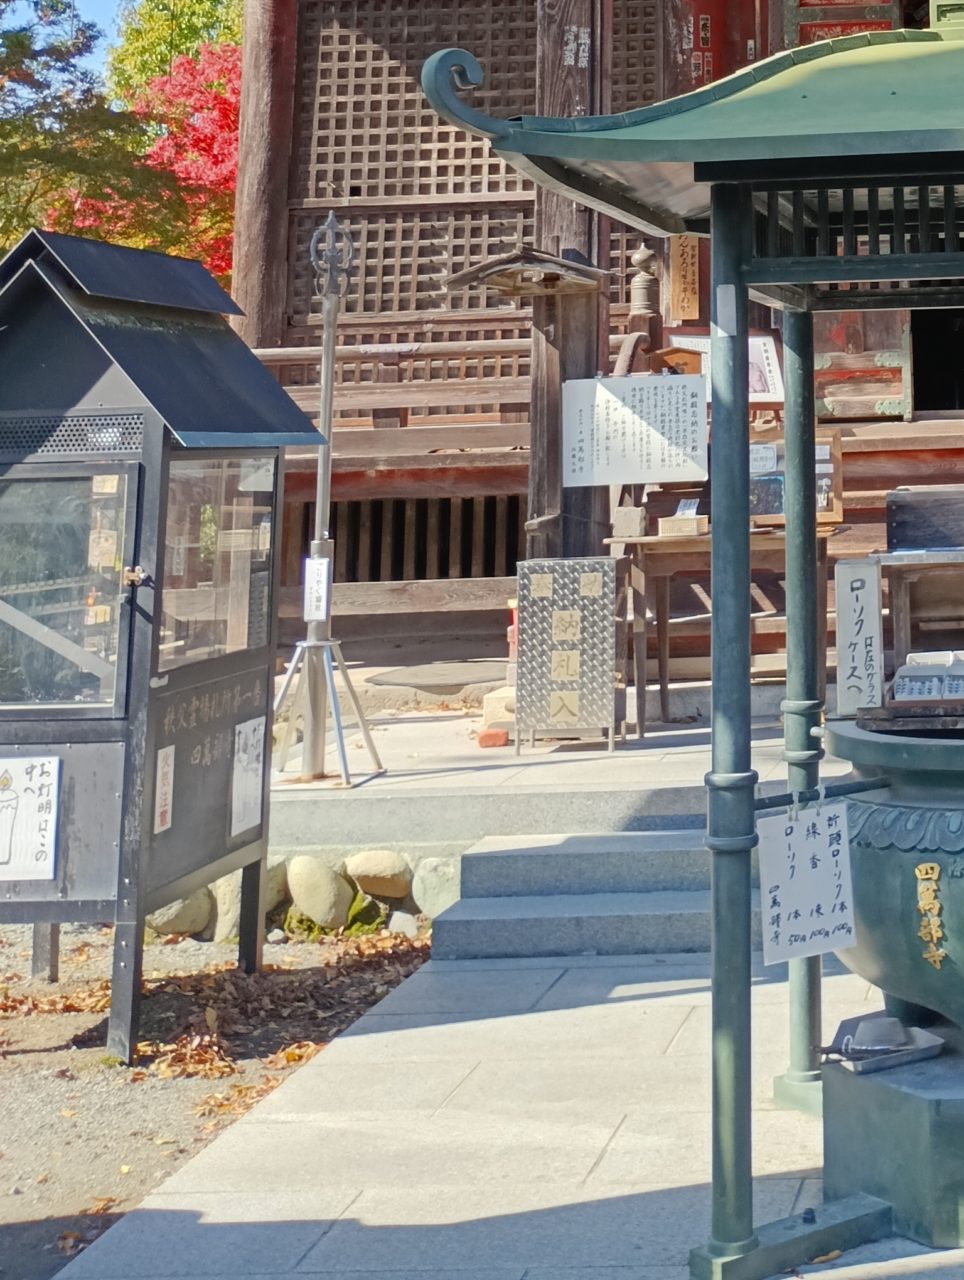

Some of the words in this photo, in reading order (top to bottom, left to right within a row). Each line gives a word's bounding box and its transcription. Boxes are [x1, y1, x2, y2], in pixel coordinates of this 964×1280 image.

[849, 578, 866, 636] ローソク
[784, 825, 796, 880] ローソク
[914, 862, 947, 970] 四萬部寺
